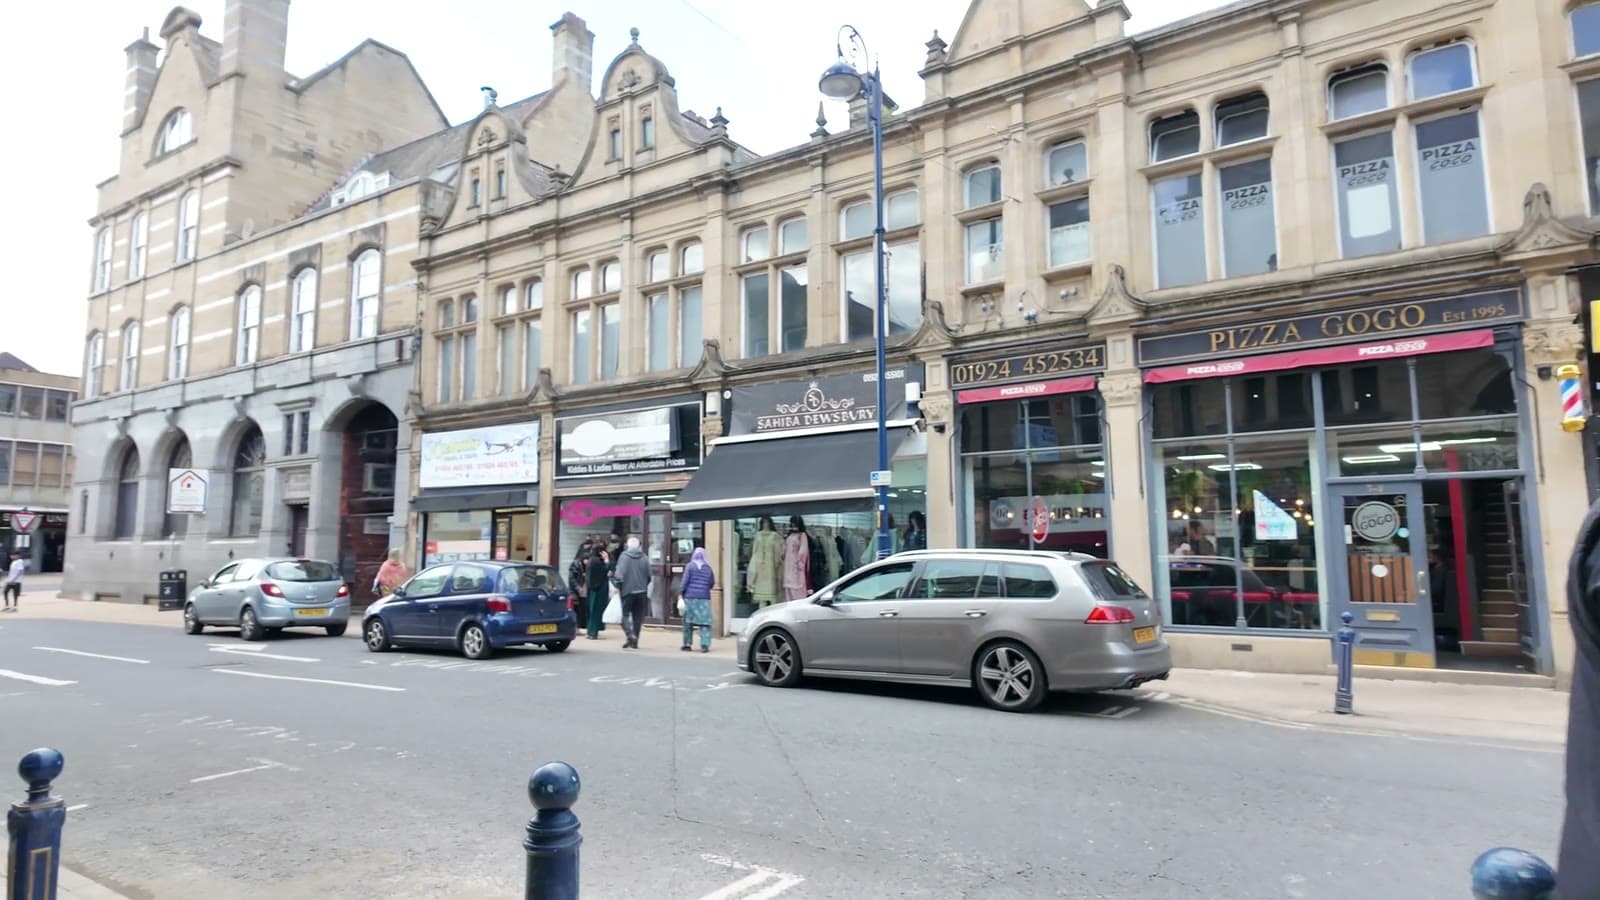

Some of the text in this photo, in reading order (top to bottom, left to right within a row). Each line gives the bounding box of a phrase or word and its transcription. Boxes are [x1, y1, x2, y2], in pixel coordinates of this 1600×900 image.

[1422, 141, 1476, 161] PIZZA
[1340, 159, 1390, 178] PIZZA
[1225, 185, 1268, 201] PIZZA
[1208, 304, 1506, 353] PIZZA GOGO Est 1995
[956, 349, 1099, 383] 01924 452534
[757, 417, 800, 430] SAHIBA
[588, 464, 593, 472] &
[593, 463, 612, 472] Ladies
[666, 458, 686, 468] Prices
[1360, 513, 1393, 530] GOGO
